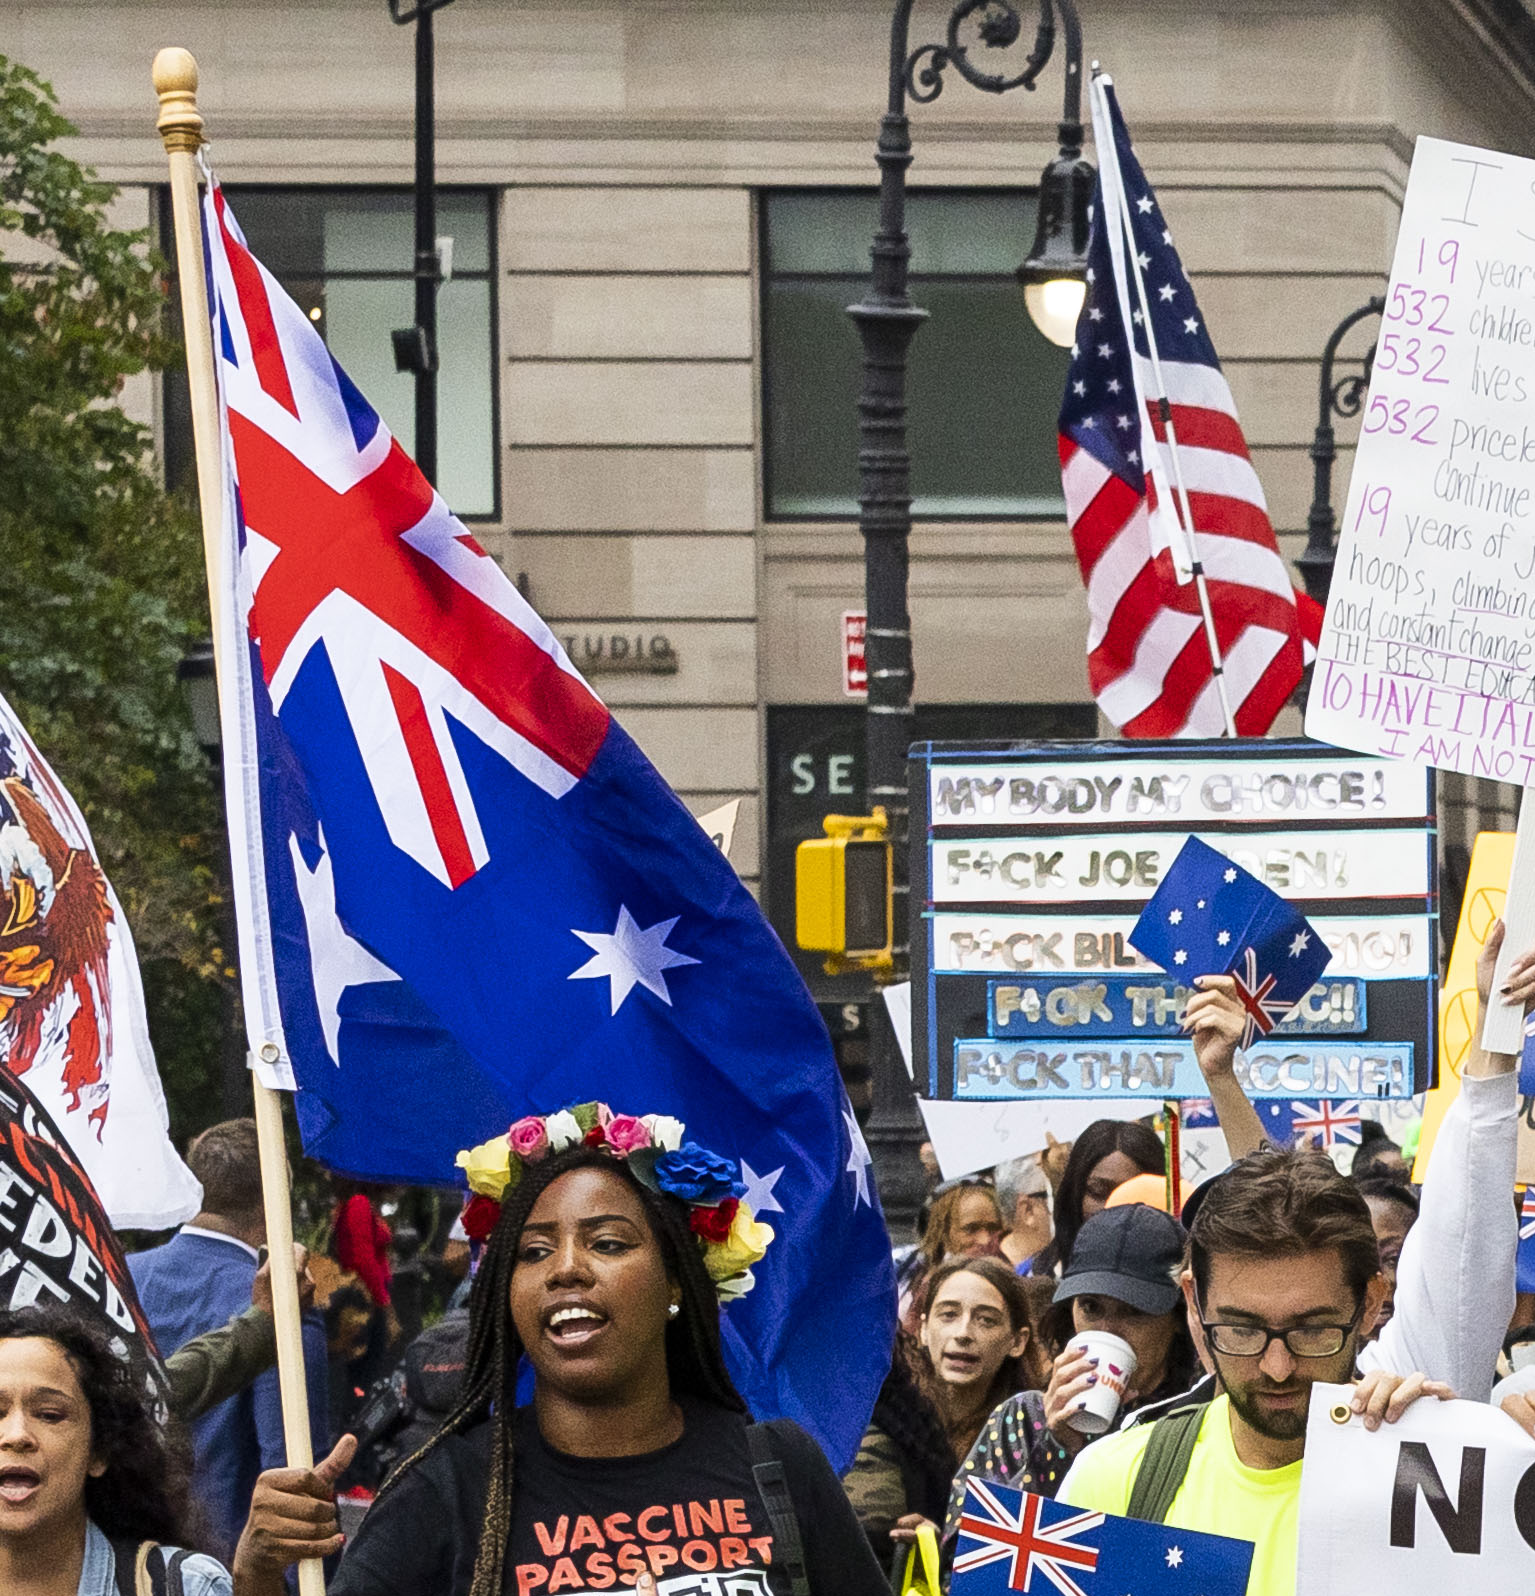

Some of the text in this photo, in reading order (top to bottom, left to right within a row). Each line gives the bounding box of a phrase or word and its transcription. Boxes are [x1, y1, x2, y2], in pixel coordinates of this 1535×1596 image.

[1441, 157, 1503, 228] I
[1417, 237, 1461, 284] 19
[1385, 283, 1456, 336] 532
[1375, 333, 1451, 384] 532
[1470, 345, 1529, 404] lives
[1363, 394, 1441, 446] 532
[1354, 482, 1393, 538] 19
[1404, 513, 1473, 558] years
[1482, 521, 1516, 559] of
[1349, 543, 1437, 607] hoops,
[563, 634, 672, 662] TUDIO
[1332, 596, 1375, 639] and
[1378, 601, 1466, 650] constant
[1328, 629, 1376, 666] THE
[1385, 641, 1457, 684] BEST
[1322, 660, 1353, 712] TO
[1358, 672, 1444, 728] HAVE
[1378, 727, 1411, 759] I
[1412, 734, 1461, 772] AM
[934, 774, 1005, 817] MY
[1007, 773, 1123, 816] BODY
[1124, 772, 1193, 814] MY
[1077, 848, 1161, 889] JOE
[1226, 848, 1350, 890] DEN!
[1073, 931, 1152, 970] BIL
[1124, 981, 1198, 1028] TH
[1072, 1050, 1186, 1092] THAT
[1232, 1053, 1406, 1096] ACCINE!
[532, 1498, 753, 1558] VACCINE
